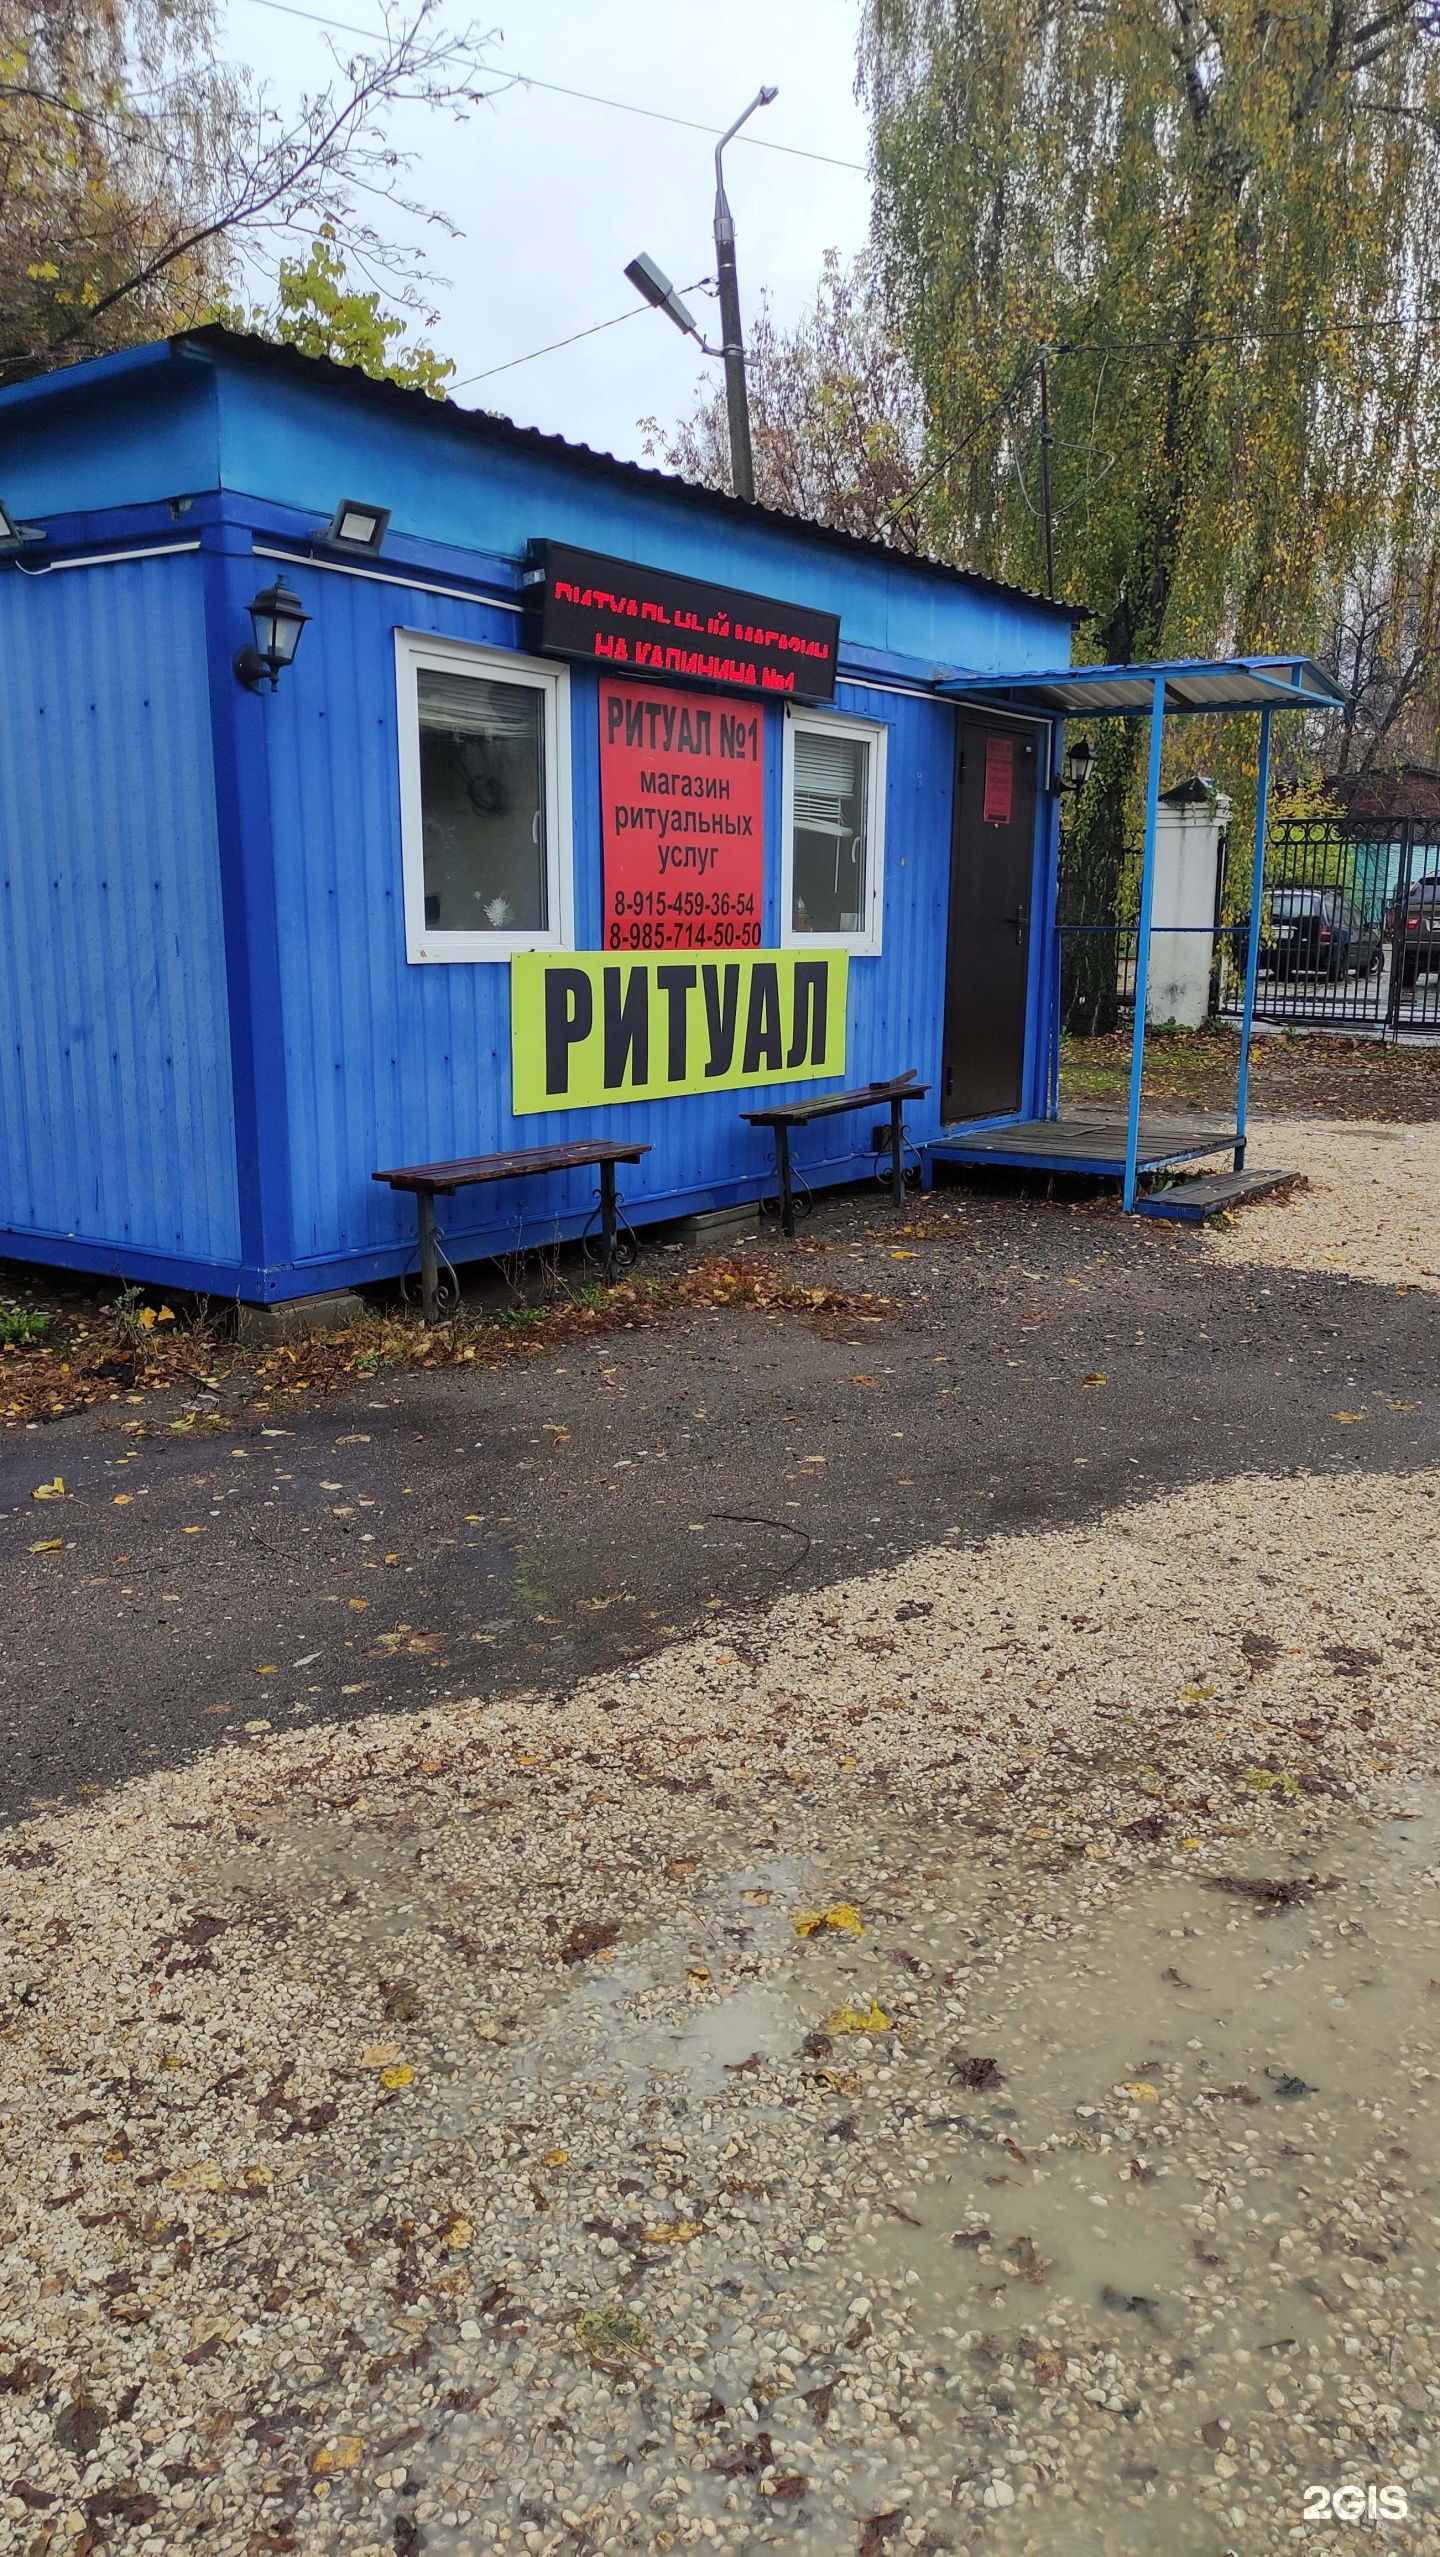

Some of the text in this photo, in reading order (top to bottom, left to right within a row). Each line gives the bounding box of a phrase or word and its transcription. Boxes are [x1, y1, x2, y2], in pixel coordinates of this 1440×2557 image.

[608, 696, 758, 762] РИТУАЛ №1
[639, 770, 731, 801] магазин
[614, 805, 754, 838] ритуальных
[657, 845, 719, 876] услуг
[614, 890, 755, 917] 8-915-459-36-54
[609, 922, 762, 950] 8-985-714-50-50
[544, 960, 829, 1096] РИТУАЛ
